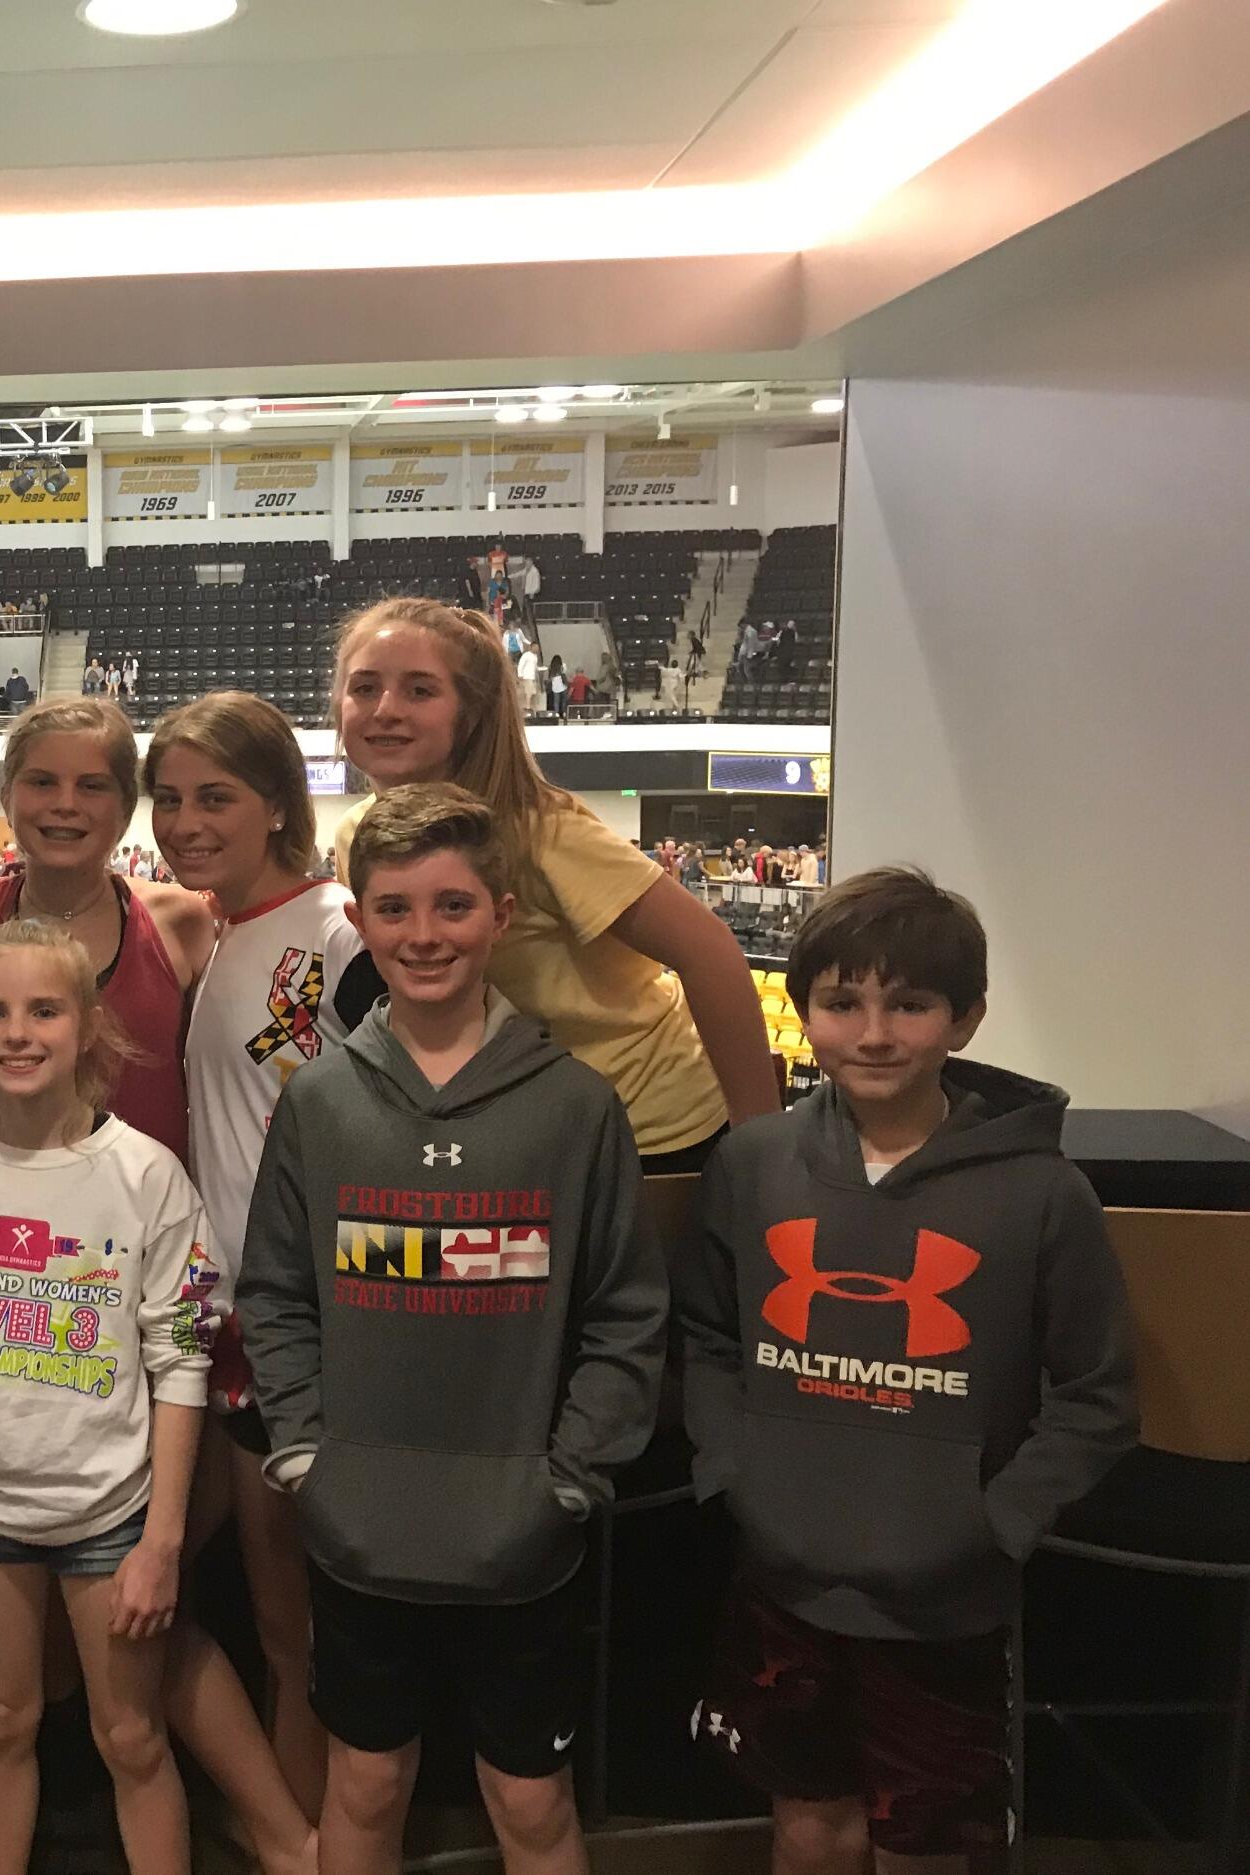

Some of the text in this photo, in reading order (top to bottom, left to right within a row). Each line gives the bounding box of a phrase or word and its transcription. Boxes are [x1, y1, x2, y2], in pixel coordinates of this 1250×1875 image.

[53, 492, 80, 502] 2000
[254, 493, 296, 507] 2007
[386, 488, 425, 503] 1996
[507, 485, 547, 500] 1999
[605, 483, 676, 496] 2013 2015
[141, 497, 178, 511] 1969
[785, 760, 801, 784] 9
[337, 1184, 551, 1220] FROSTBURG
[29, 1277, 122, 1307] WOMEN'S
[334, 1278, 549, 1315] STATE UNIVERSITY
[67, 1306, 100, 1351] 3
[756, 1342, 969, 1396] BALTIMORE
[797, 1377, 913, 1408] ORIOLES
